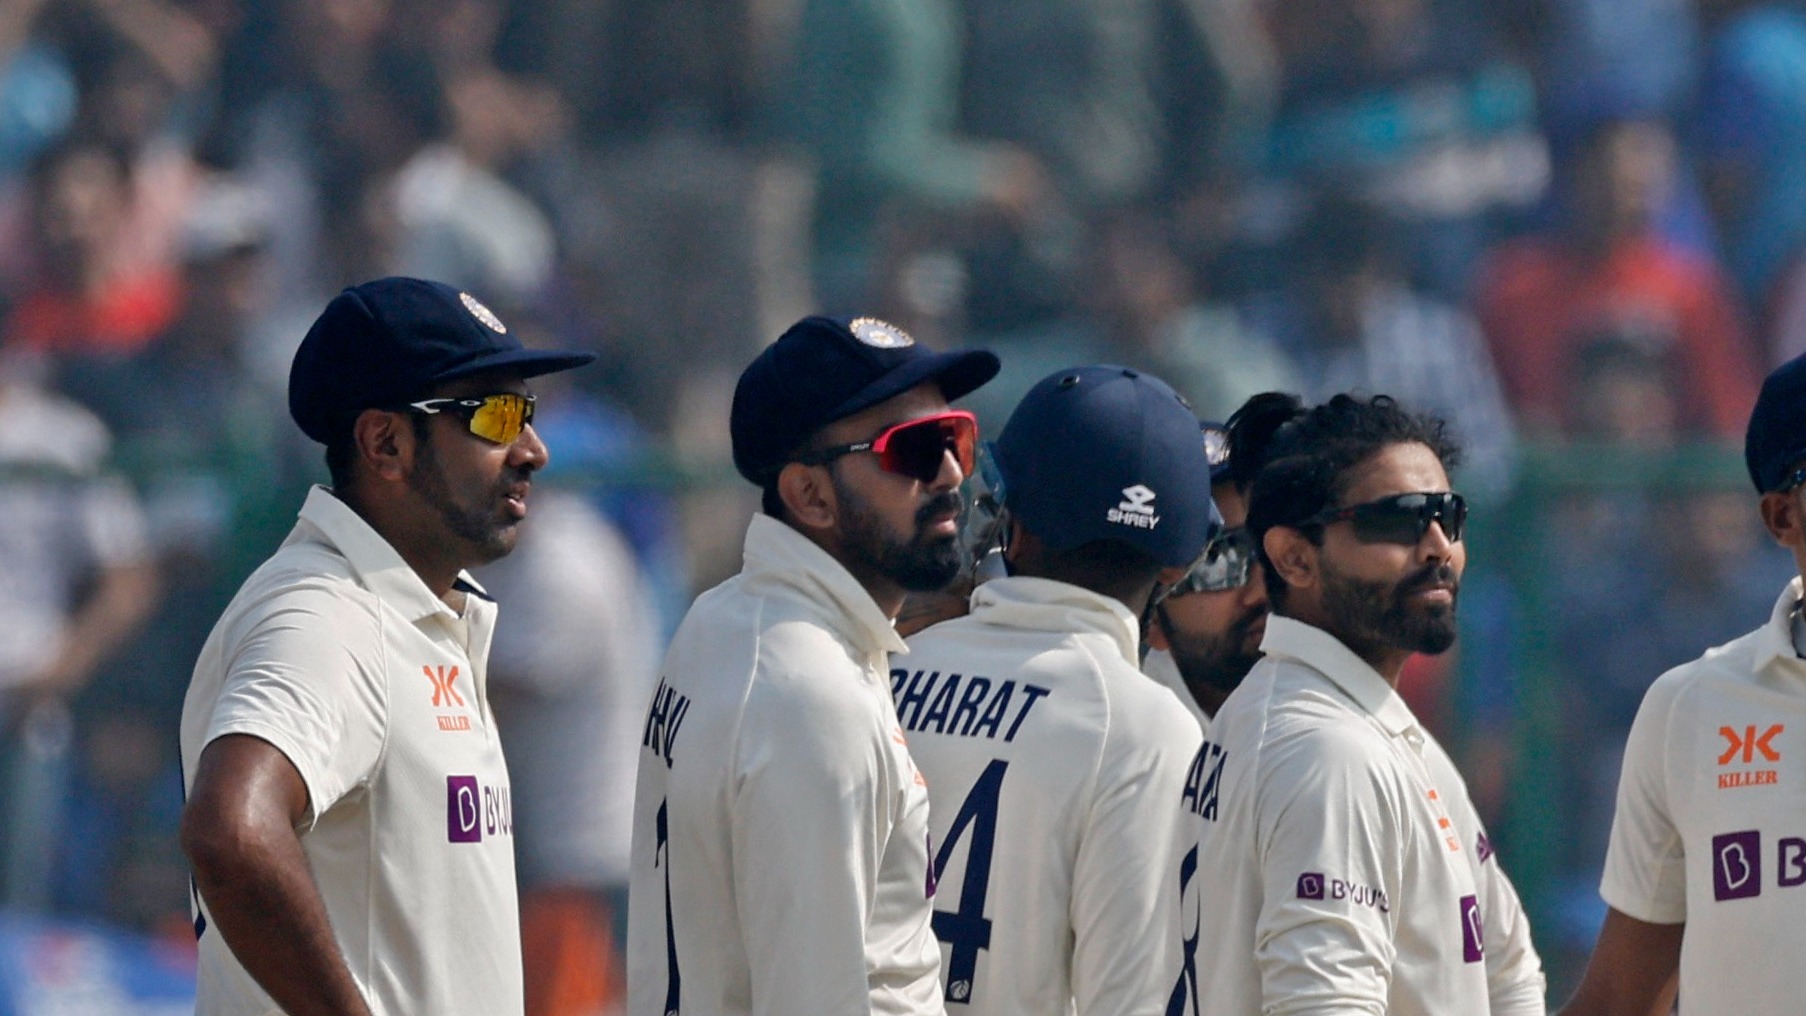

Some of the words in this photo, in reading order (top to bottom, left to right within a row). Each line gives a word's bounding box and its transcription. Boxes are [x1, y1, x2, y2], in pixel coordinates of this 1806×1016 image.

[1107, 508, 1161, 530] SHREY
[437, 716, 471, 731] KILLER
[1718, 770, 1778, 789] KILLER
[931, 759, 1009, 1004] 4
